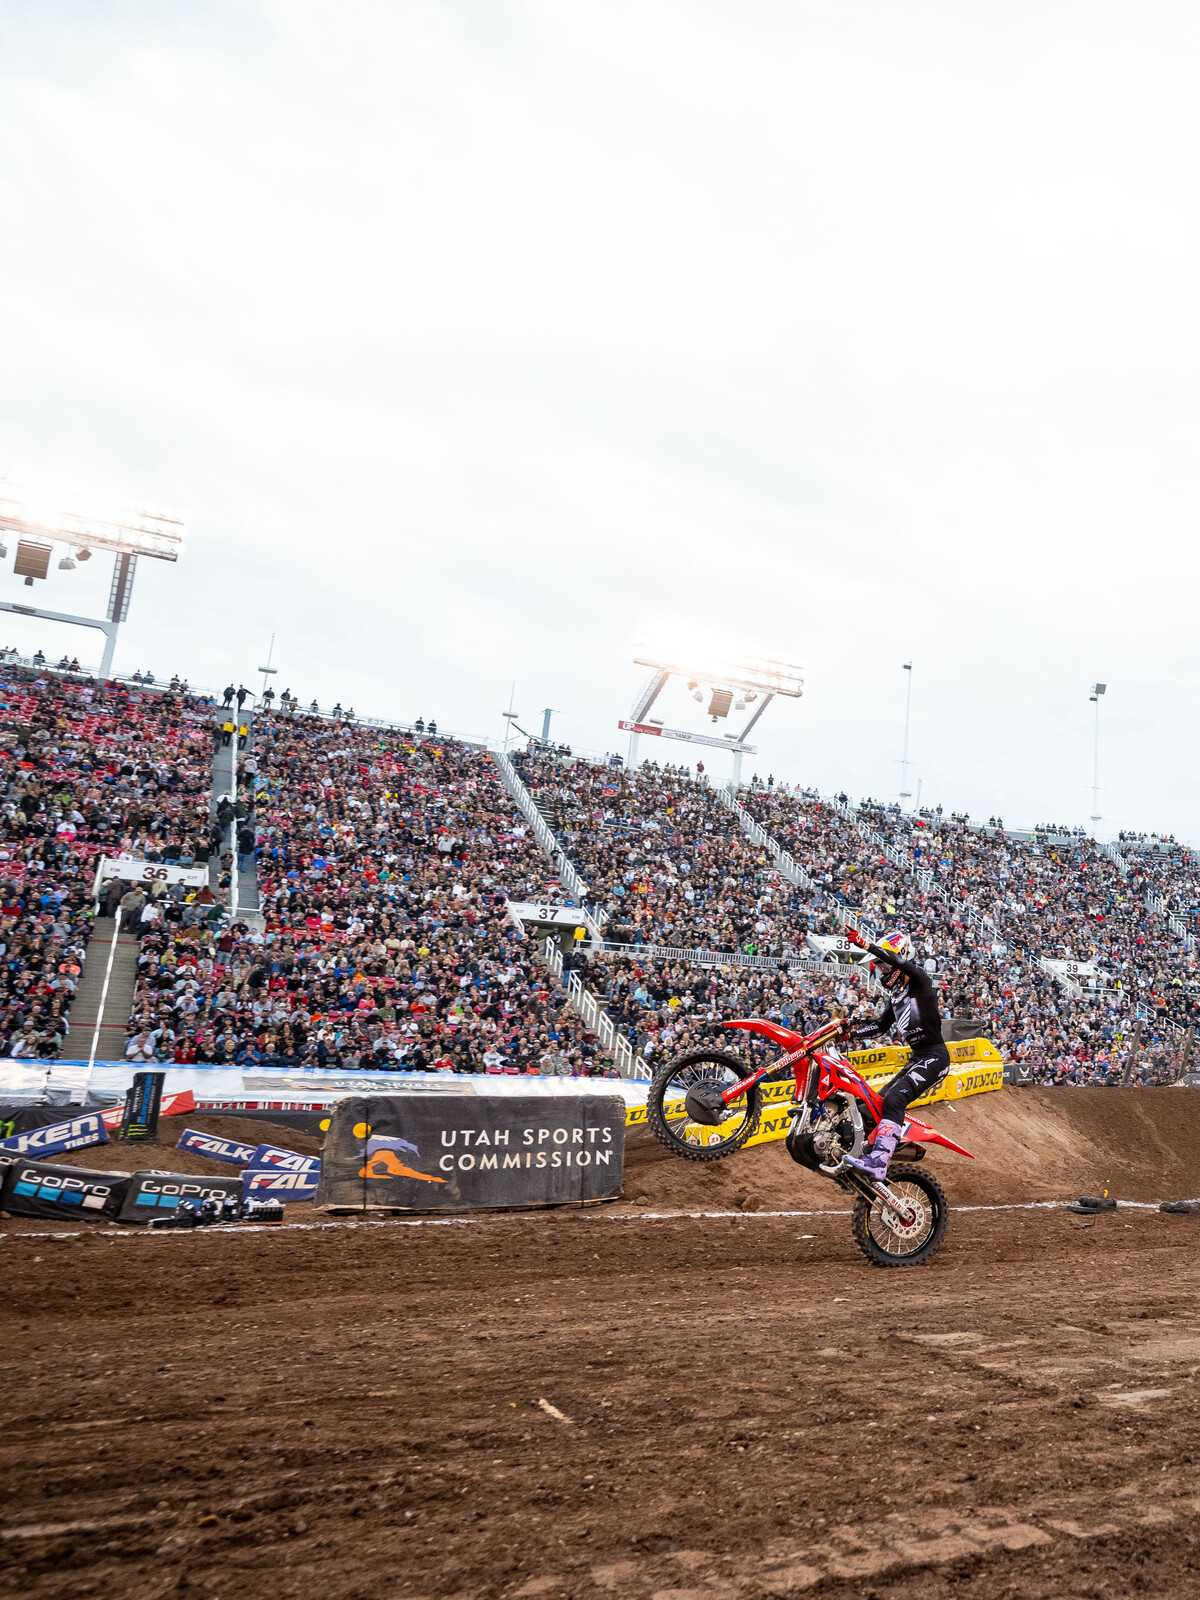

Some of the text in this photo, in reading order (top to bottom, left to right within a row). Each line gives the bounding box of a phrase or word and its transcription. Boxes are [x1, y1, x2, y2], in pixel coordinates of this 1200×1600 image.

[142, 867, 169, 881] 36
[538, 908, 559, 920] 37
[836, 940, 851, 950] 38
[1066, 963, 1079, 973] 39
[778, 1049, 802, 1068] SHOWA
[955, 1045, 976, 1057] DUNLOP
[726, 1075, 757, 1095] DUNLOP
[965, 1071, 1003, 1091] DUNLOP
[64, 1132, 100, 1149] TIRES
[441, 1127, 613, 1147] UTAH SPORTS
[21, 1169, 111, 1196] GoPro
[141, 1180, 227, 1199] GoPro
